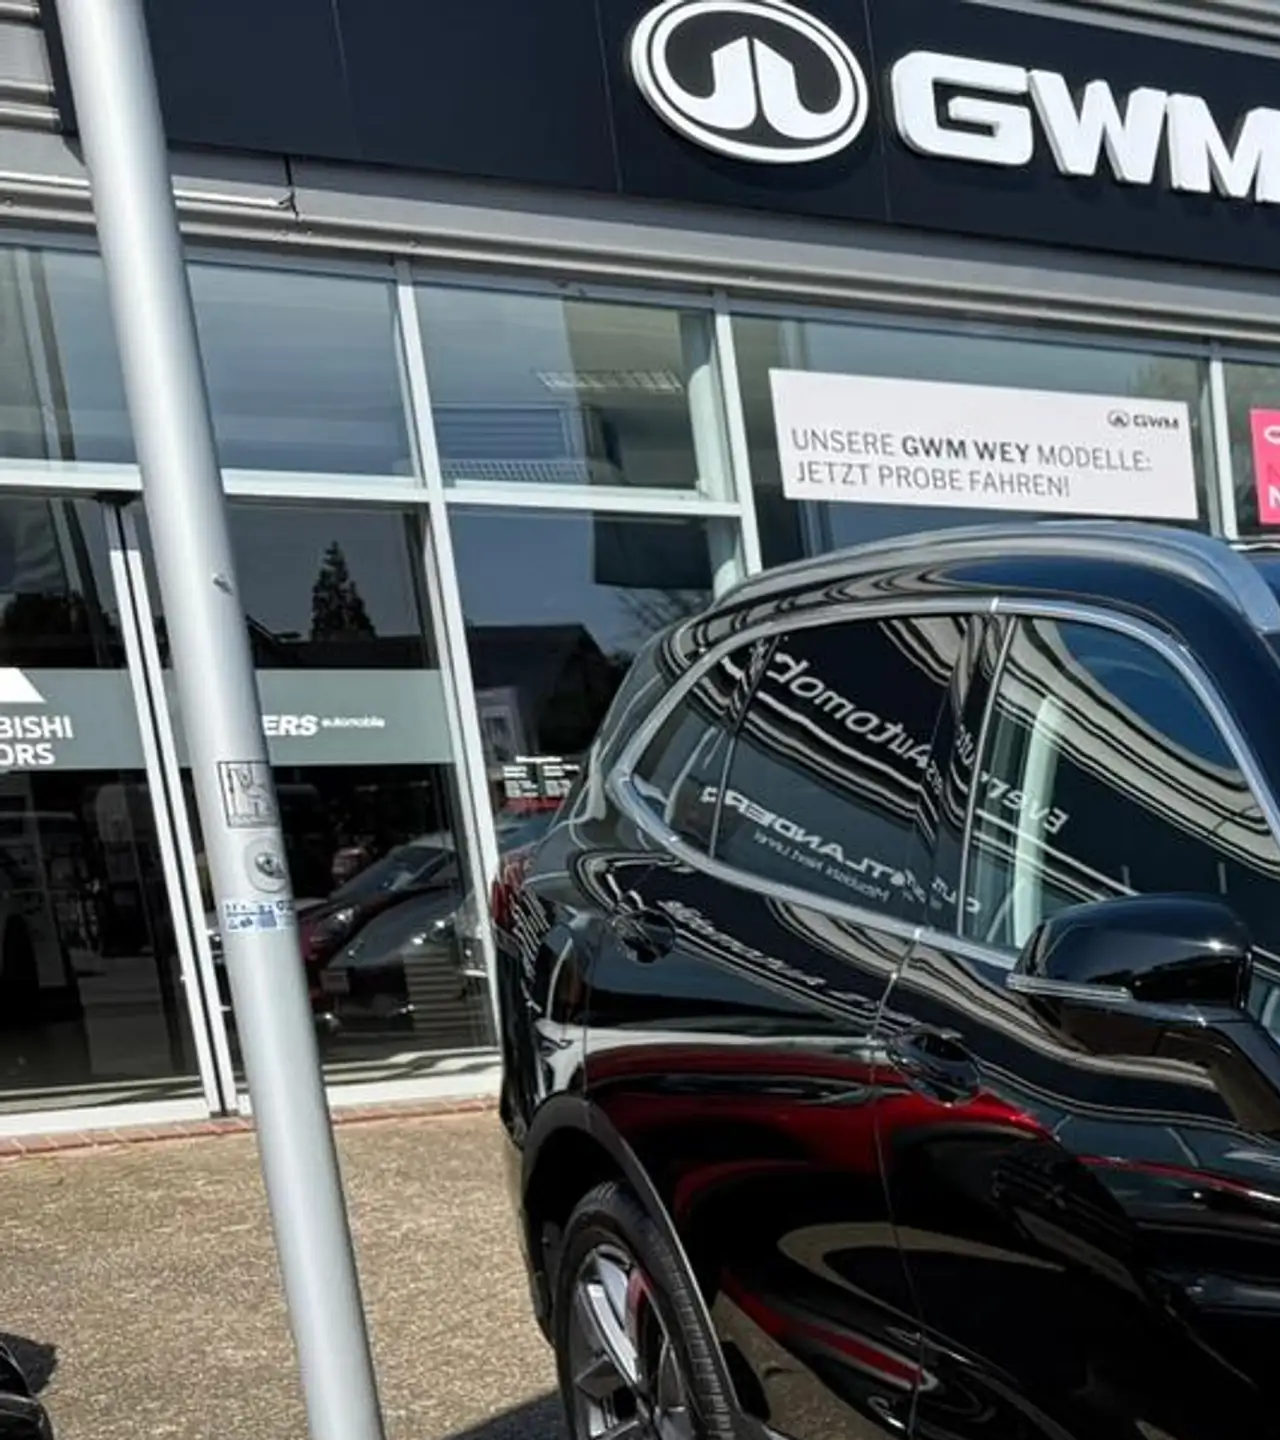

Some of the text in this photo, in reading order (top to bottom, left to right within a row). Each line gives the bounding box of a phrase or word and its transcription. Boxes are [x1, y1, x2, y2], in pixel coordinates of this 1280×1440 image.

[1133, 414, 1179, 429] GWM
[791, 428, 1152, 472] UNSERE GWM WEY MODELLE:
[796, 461, 1071, 498] JETZT PROBE FAHREN!
[0, 714, 74, 739] BISHI
[262, 714, 319, 736] ERS
[0, 742, 56, 767] ORS
